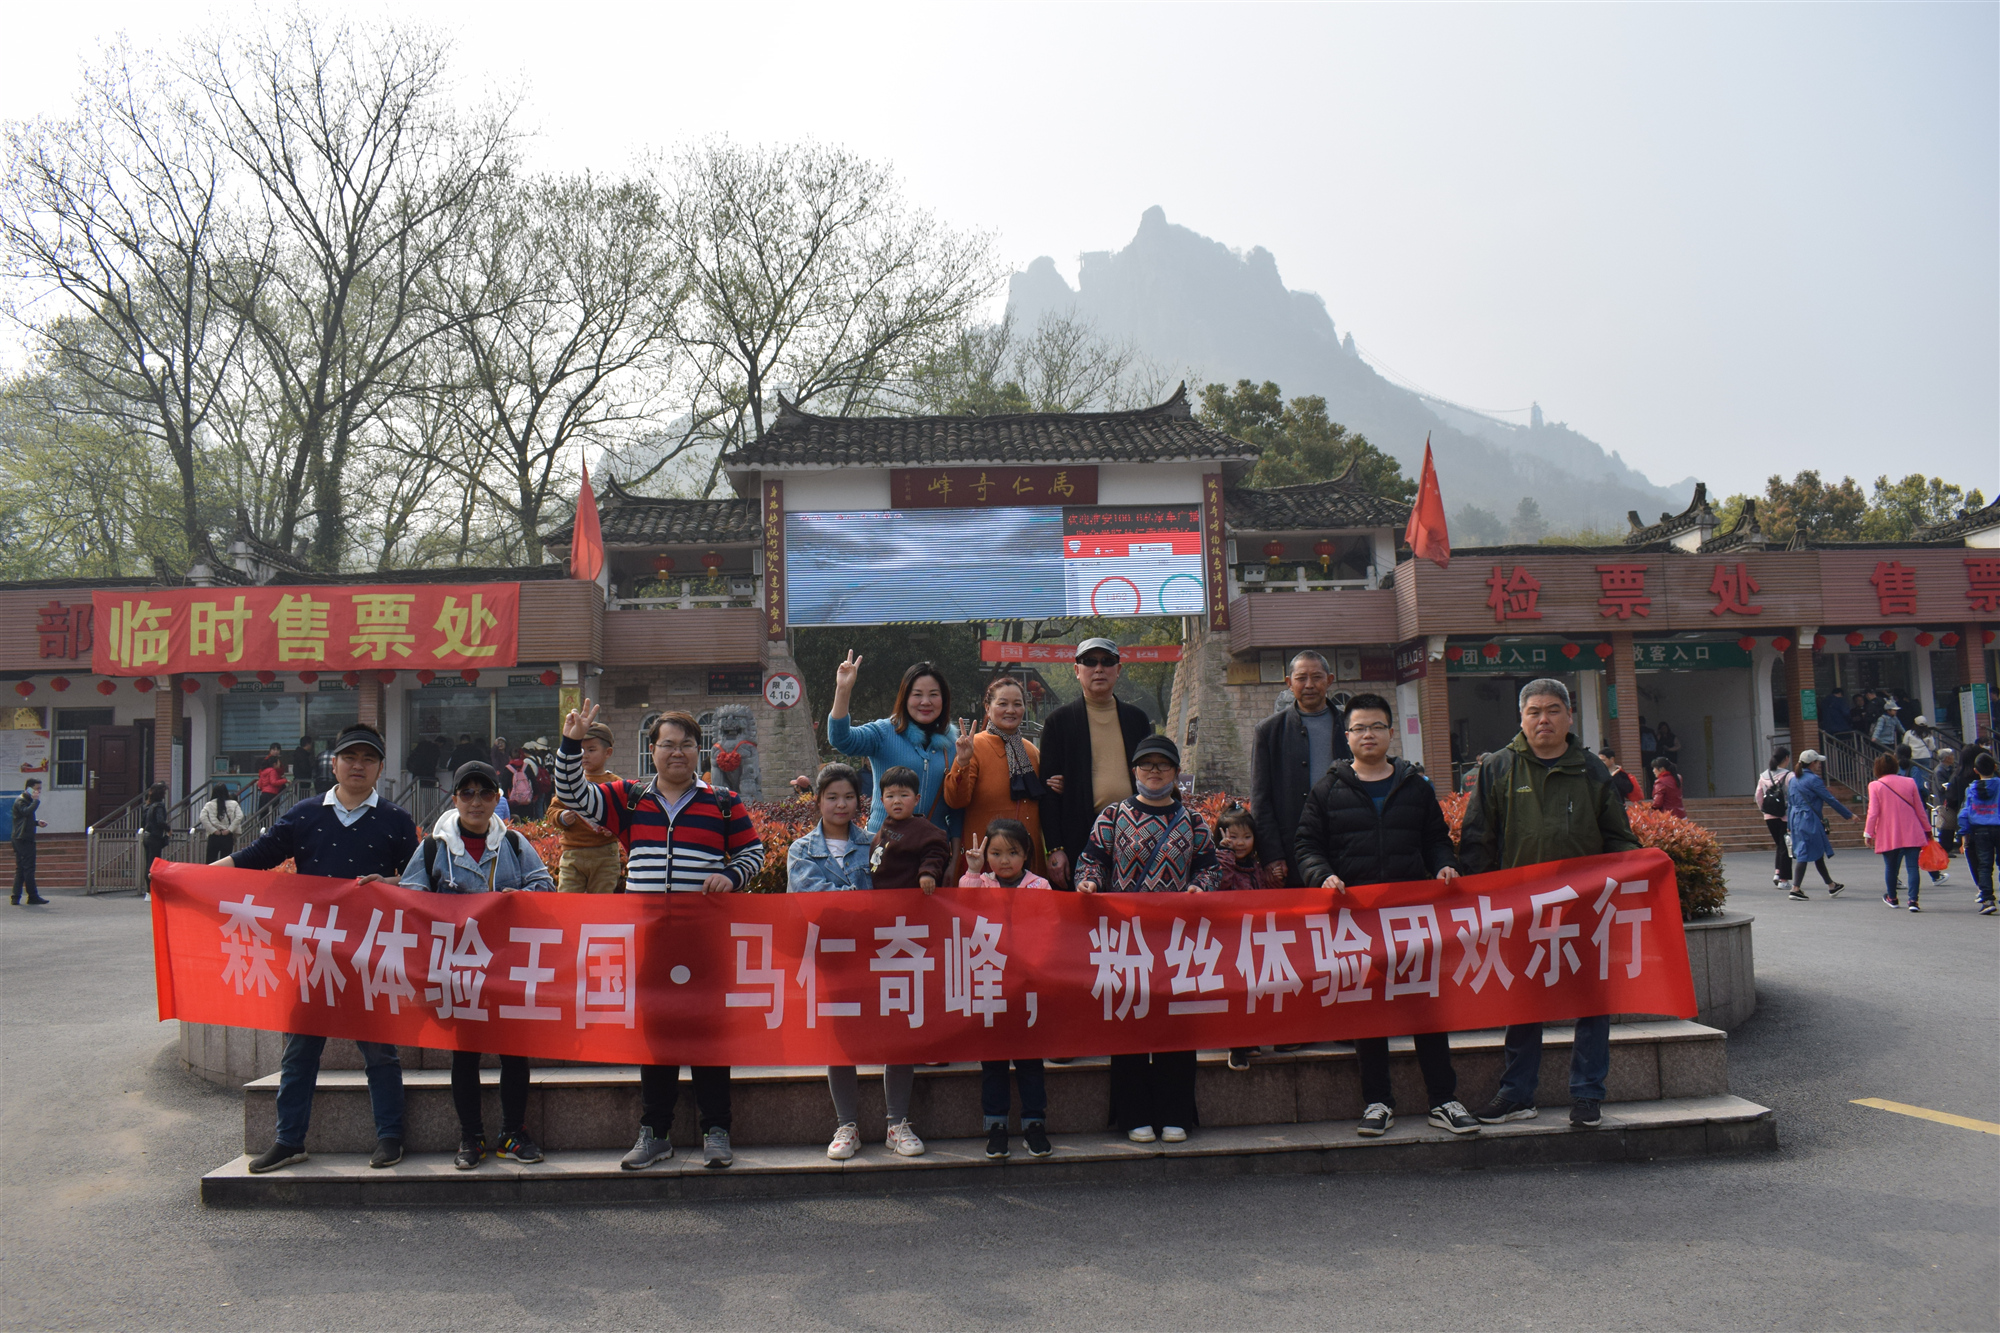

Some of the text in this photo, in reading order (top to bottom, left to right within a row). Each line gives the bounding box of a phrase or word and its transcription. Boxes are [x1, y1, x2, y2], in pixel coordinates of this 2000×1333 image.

[1486, 564, 1764, 622] 检票处
[36, 600, 94, 660] 部
[109, 592, 500, 669] 临时售票处
[772, 681, 794, 690] 限高
